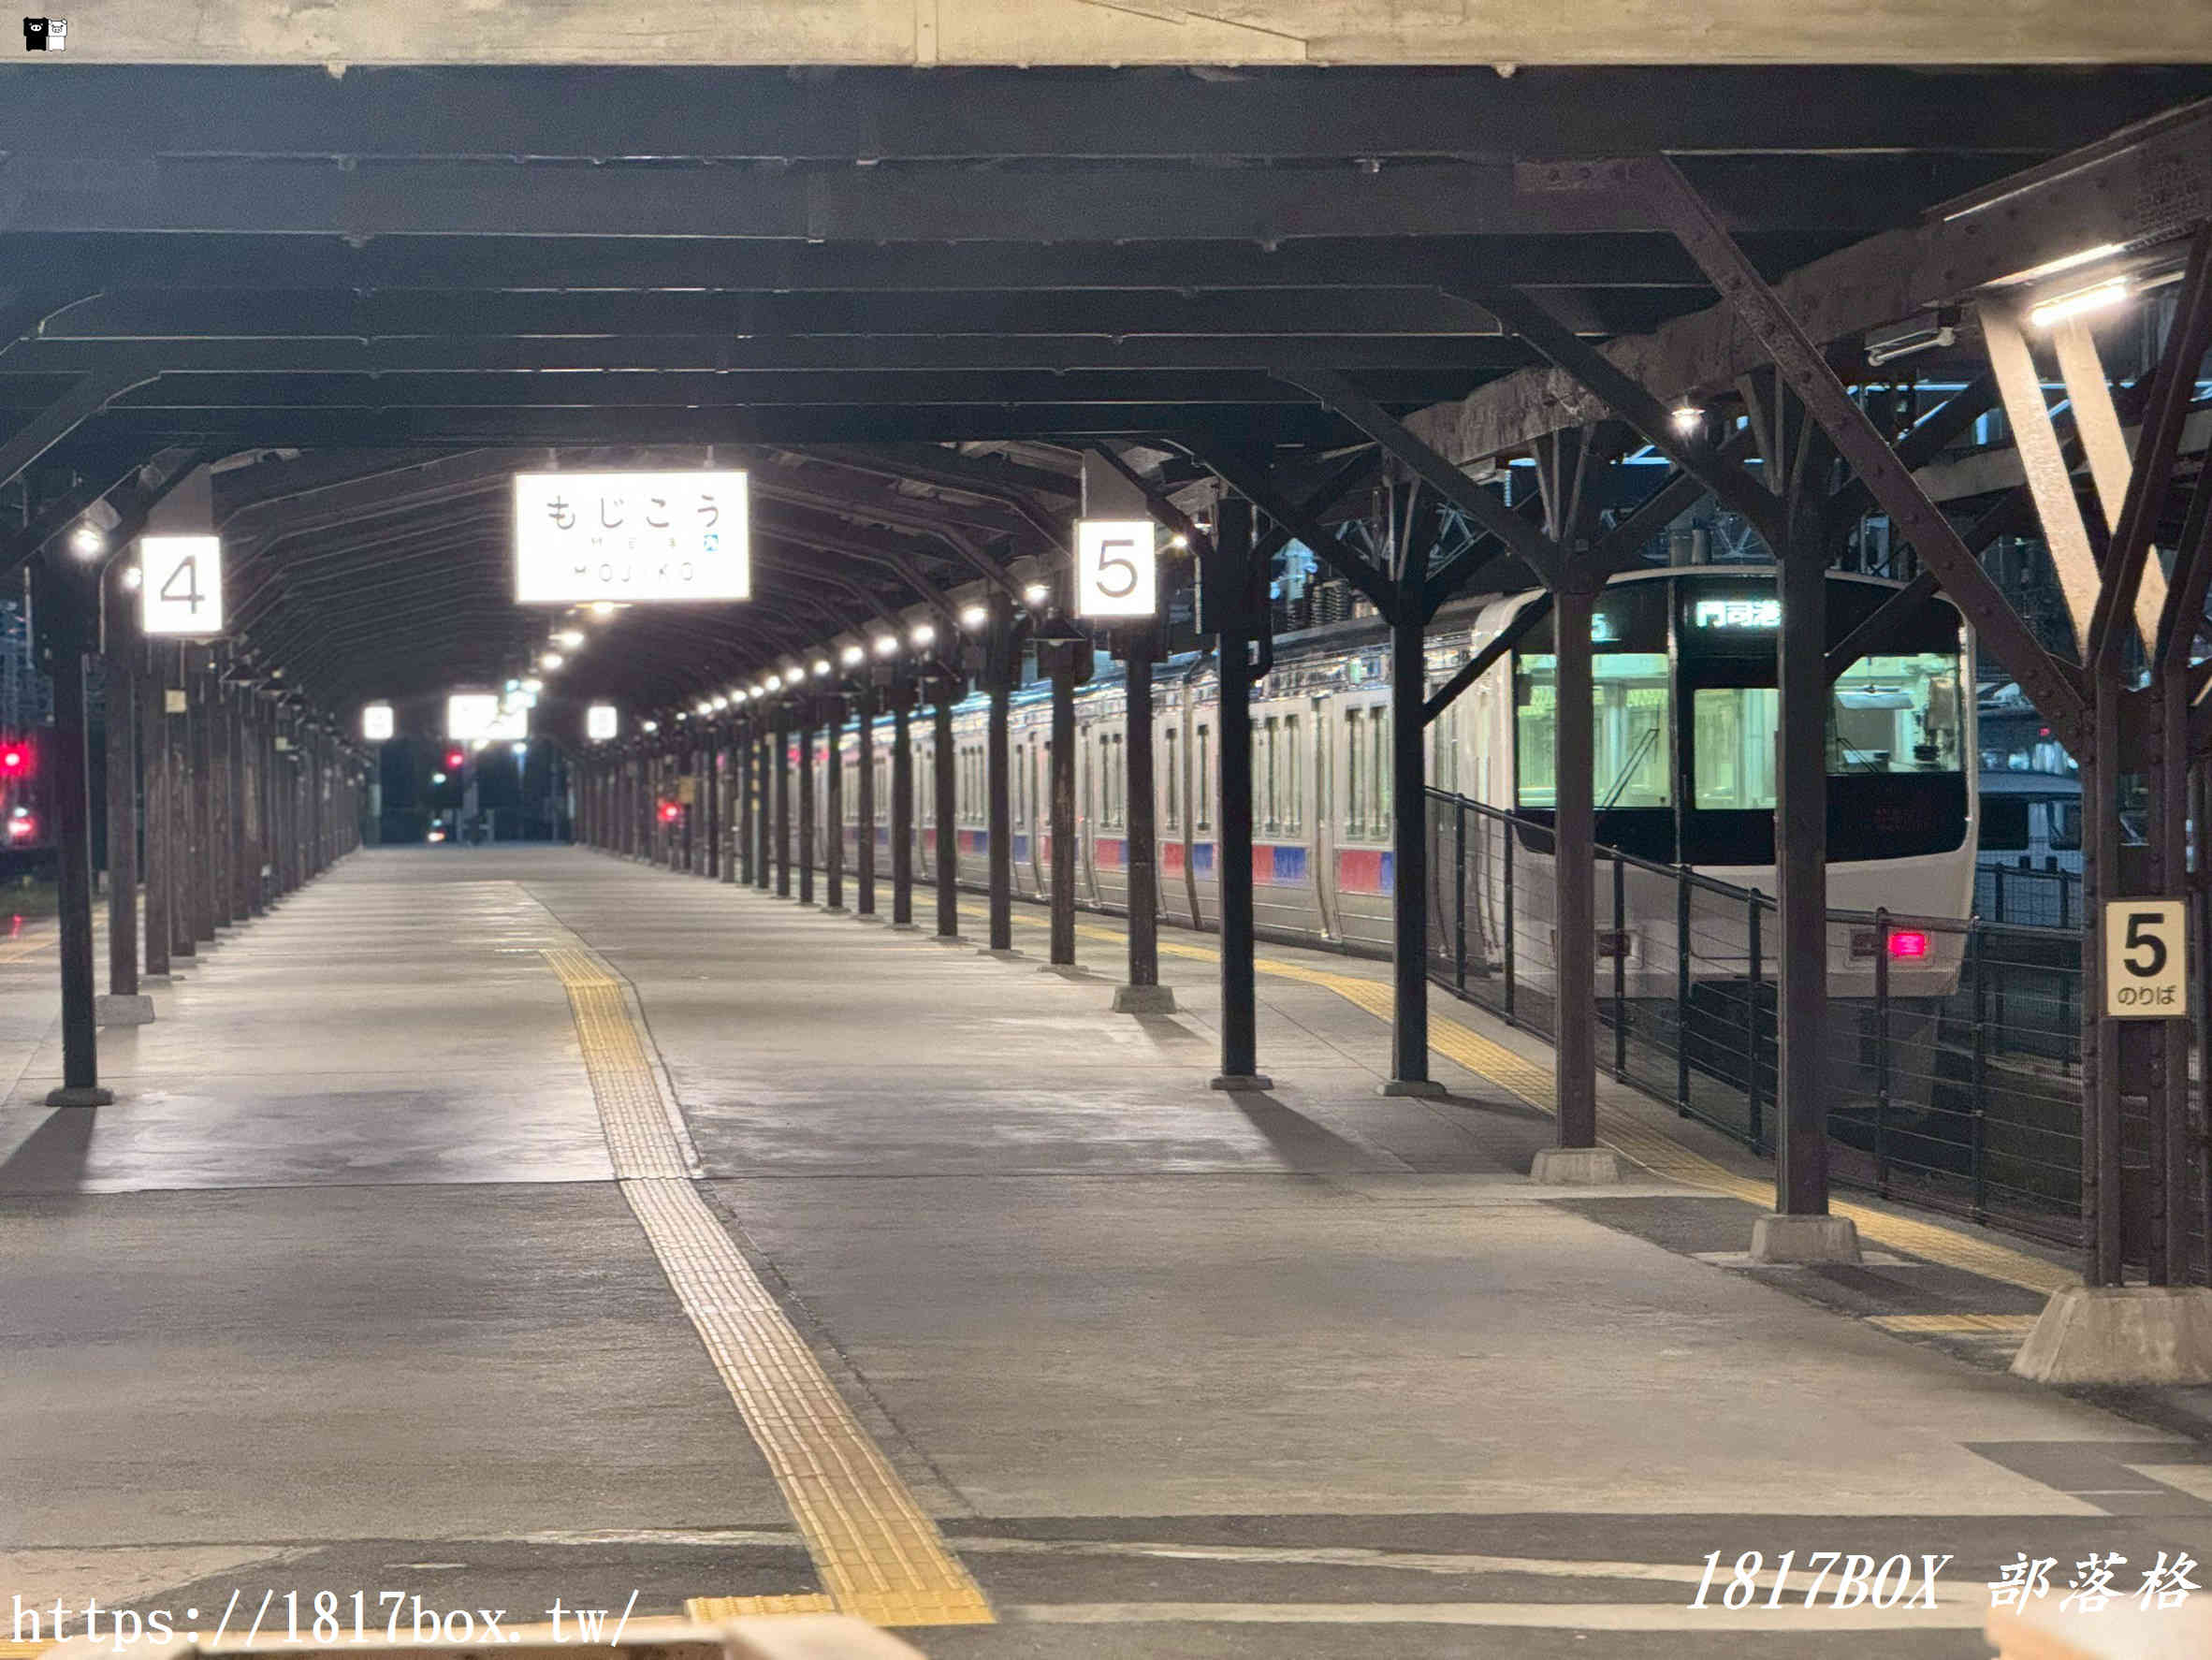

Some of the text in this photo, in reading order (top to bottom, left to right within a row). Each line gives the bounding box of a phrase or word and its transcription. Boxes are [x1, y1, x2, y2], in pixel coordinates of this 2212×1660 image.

[547, 494, 719, 531] もじこう
[160, 555, 205, 614] 4
[1096, 539, 1138, 598] 5
[2123, 912, 2167, 978] 5
[2117, 984, 2177, 1006] のりば
